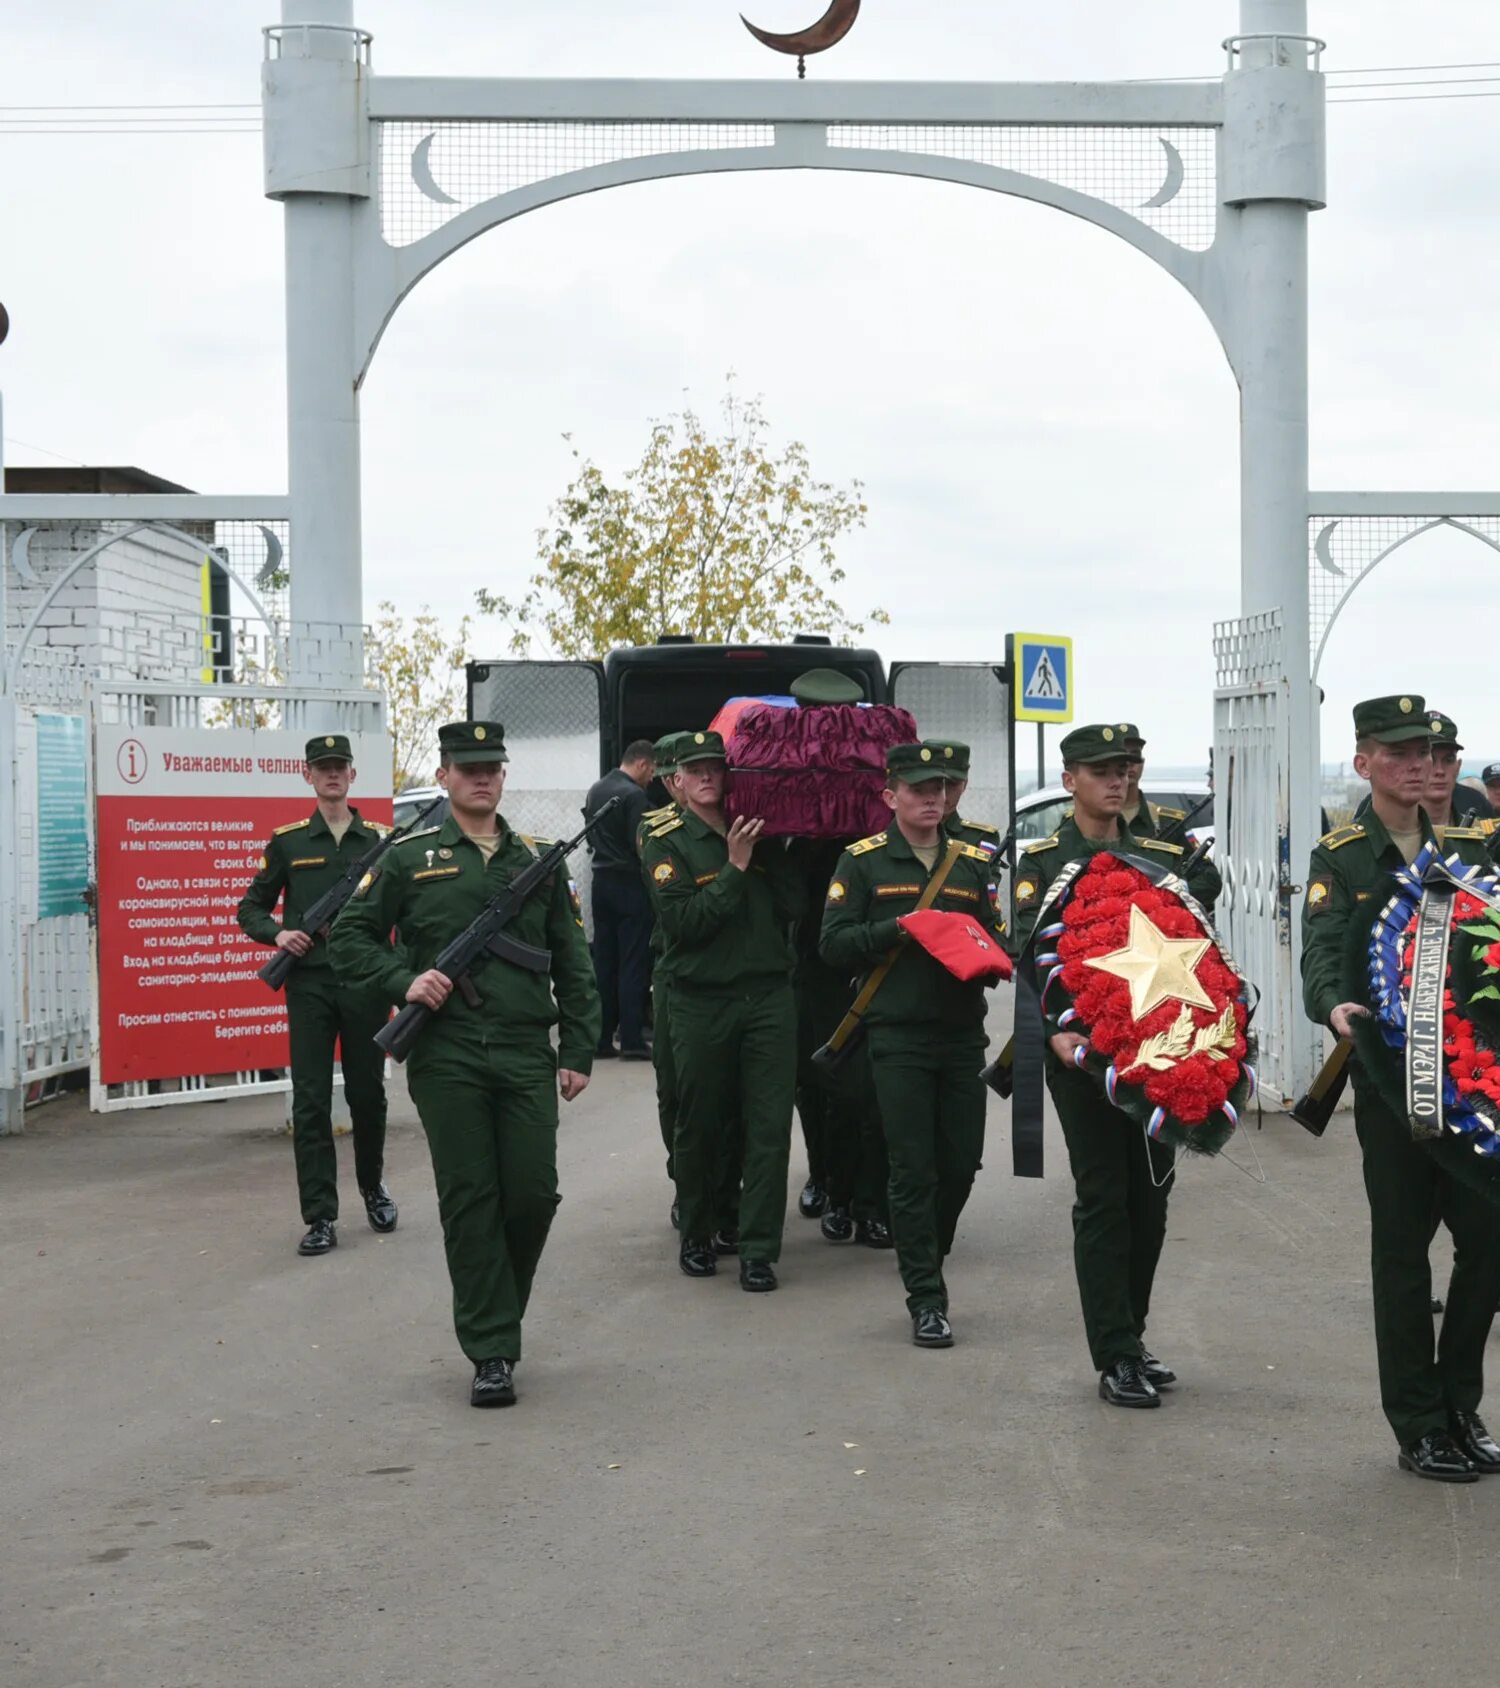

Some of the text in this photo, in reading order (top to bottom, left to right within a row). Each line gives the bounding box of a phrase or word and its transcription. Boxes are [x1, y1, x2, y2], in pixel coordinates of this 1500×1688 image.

[162, 753, 253, 773] Уважаемые
[126, 818, 254, 833] Приближаются великие
[120, 841, 128, 851] и
[129, 840, 146, 851] мы
[148, 840, 207, 852] понимаем,
[208, 840, 225, 850] что
[227, 840, 241, 850] вы
[213, 856, 263, 869] своих бл
[136, 877, 182, 891] Однако,
[191, 877, 221, 889] связи
[222, 877, 230, 888] с
[231, 876, 254, 890] рас
[118, 894, 209, 911] коронавирусной
[128, 915, 210, 929] самоизоляции,
[211, 914, 228, 926] мы
[144, 937, 158, 948] на
[159, 933, 214, 948] кладбище
[122, 955, 151, 969] Вход
[152, 956, 166, 967] на
[167, 951, 222, 966] кладбище
[223, 950, 253, 965] будет
[1413, 936, 1443, 1023] НАБЕРЕЖНЫЕ
[118, 1013, 161, 1028] Просим
[163, 1009, 217, 1024] отнестись
[219, 1008, 226, 1019] с
[215, 1025, 261, 1040] Берегите
[1412, 1043, 1437, 1085] МЭРА
[1413, 1090, 1436, 1117] ОТ
